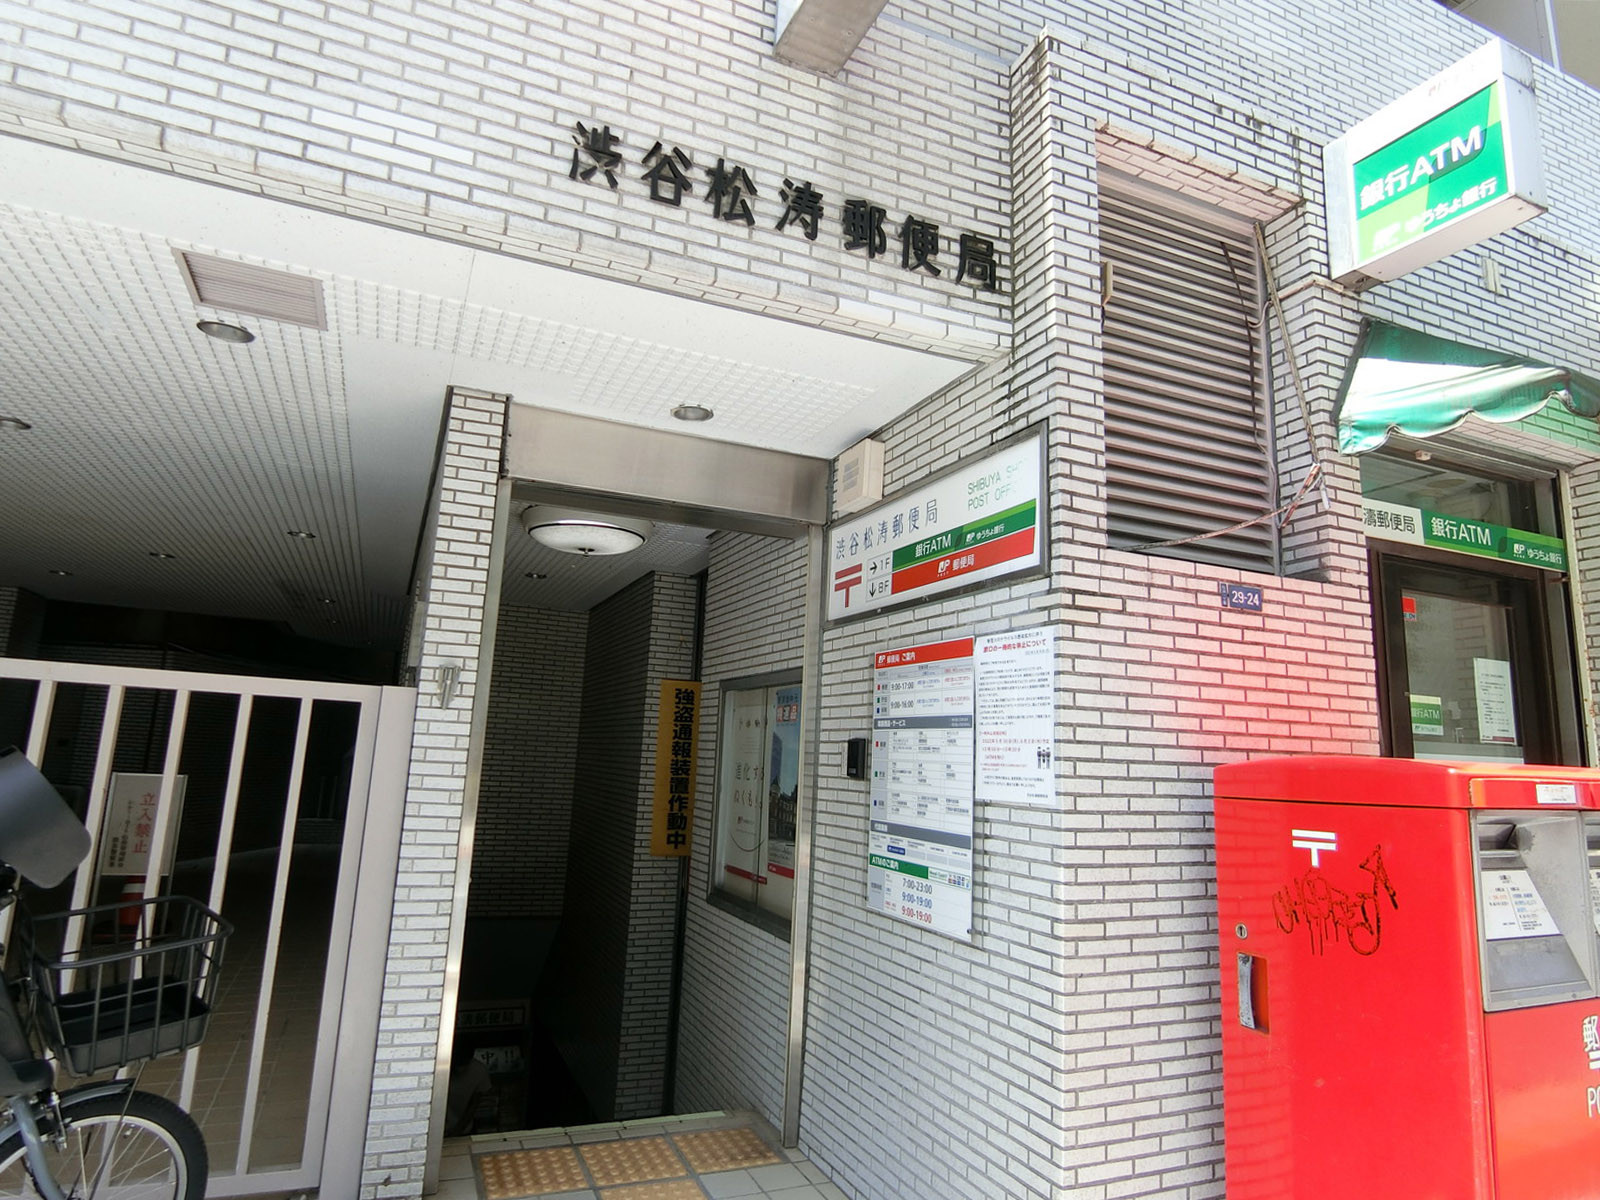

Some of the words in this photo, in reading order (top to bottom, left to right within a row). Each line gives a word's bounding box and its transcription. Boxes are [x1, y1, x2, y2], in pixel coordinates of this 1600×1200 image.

[1359, 124, 1483, 212] 銀行ATM
[568, 121, 998, 292] 渋谷松涛郵便局
[967, 471, 1001, 495] SHIBUYA
[967, 492, 990, 511] POST
[835, 498, 939, 560] 渋谷松涛郵便局
[1430, 516, 1492, 546] 銀行ATM
[914, 533, 952, 558] 銀行ATM
[879, 557, 890, 571] 1F
[952, 553, 975, 571] 郵便局
[1231, 590, 1260, 606] 29-24
[666, 688, 696, 850] 強盗通報装置作動中
[131, 792, 156, 854] 立入禁止
[871, 856, 899, 871] ATMのご案内
[902, 877, 933, 895] 7:00-23:00
[901, 892, 933, 909] 9:00-19:00
[901, 907, 933, 924] 9:00-19:00
